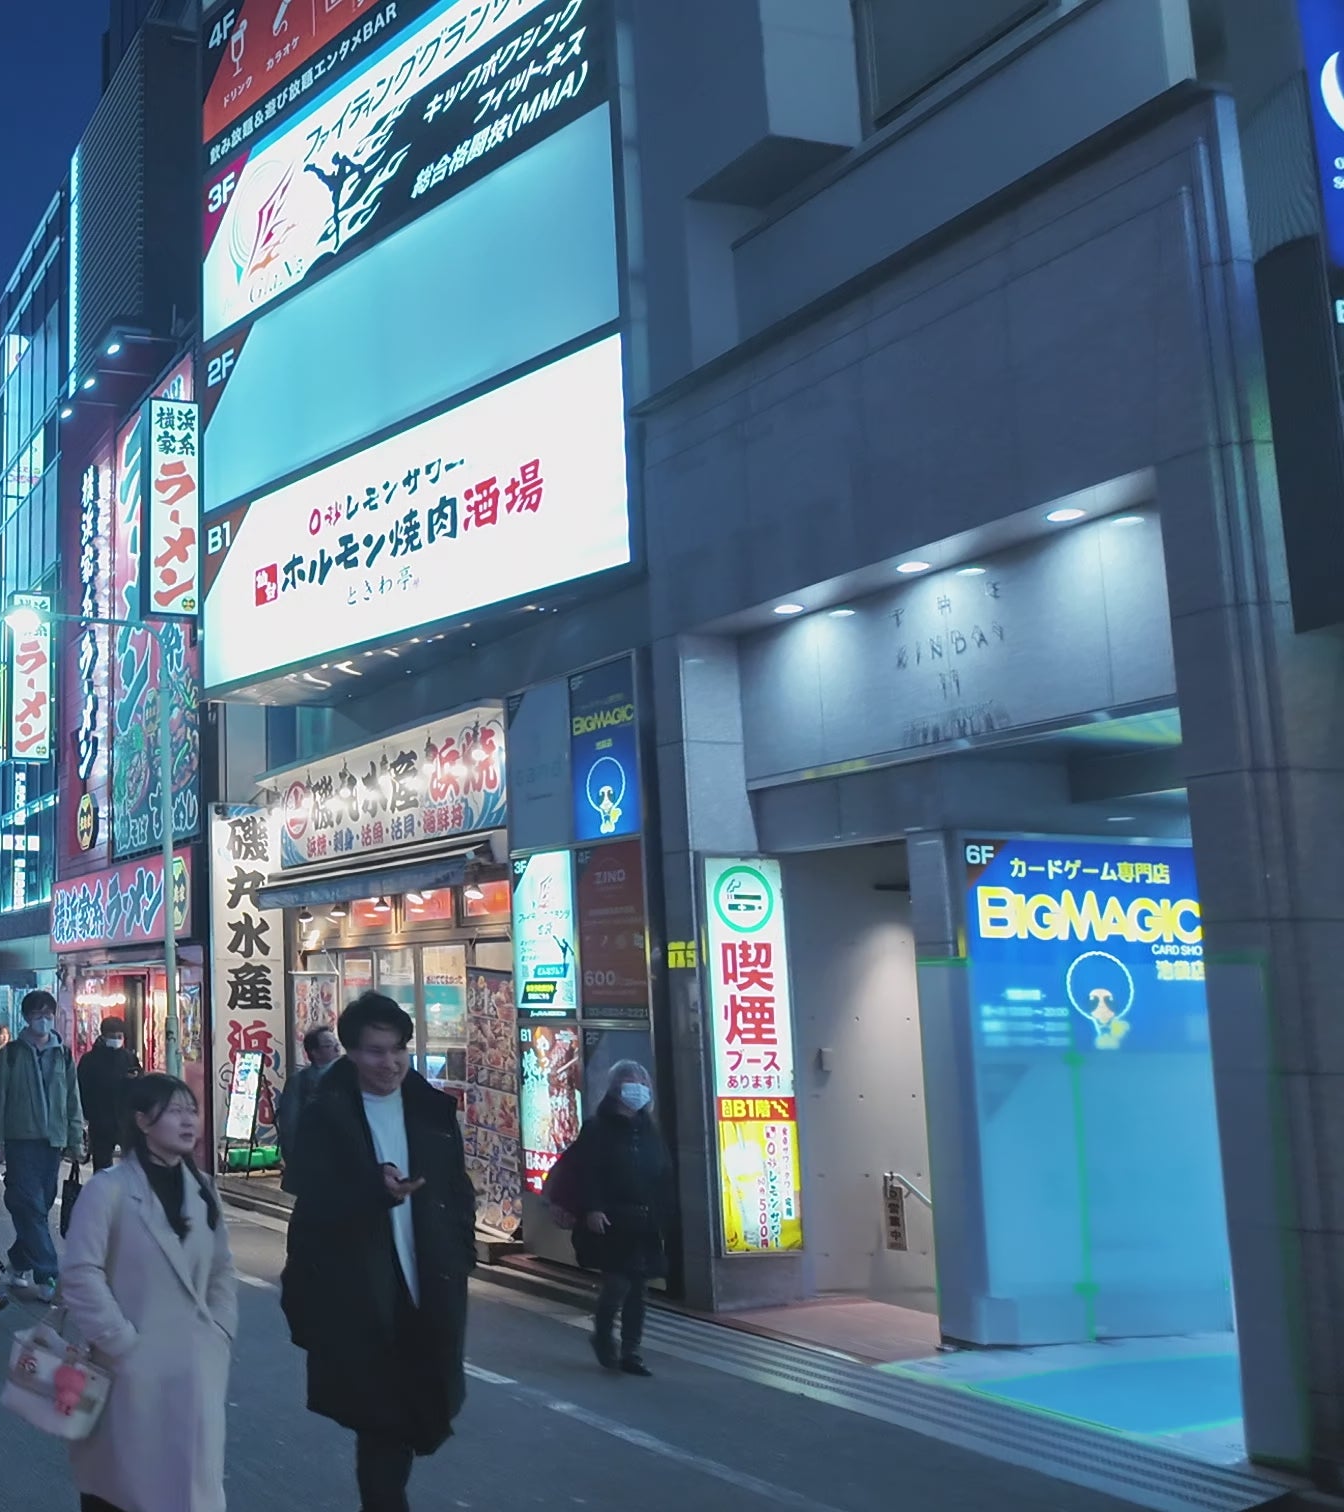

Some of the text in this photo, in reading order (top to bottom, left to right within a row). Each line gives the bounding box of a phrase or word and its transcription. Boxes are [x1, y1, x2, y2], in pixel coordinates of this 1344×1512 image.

[208, 9, 236, 49] 4F
[266, 36, 301, 72] カラオケ
[223, 75, 254, 108] ドリンク
[303, 0, 524, 163] ファイティンググラン
[473, 26, 587, 124] フィットネス
[207, 172, 236, 213] 3F
[207, 352, 235, 387] 2F
[155, 406, 197, 432] 横浜
[155, 431, 197, 456] 家系
[153, 460, 197, 608] ラーメン
[207, 524, 231, 556] B1
[281, 457, 545, 593] ホルモン焼肉酒場
[346, 565, 413, 605] ときわ亭
[15, 640, 47, 753] ラーメン
[572, 703, 634, 737] BIGMAGIC
[965, 845, 995, 865] 6F
[1009, 857, 1171, 885] カードゲーム専門店
[976, 885, 1204, 944] BIGMAGIC
[1151, 944, 1179, 956] CARD
[721, 940, 777, 1046] 喫煙
[726, 1050, 781, 1072] ブース
[727, 1074, 781, 1089] あります!
